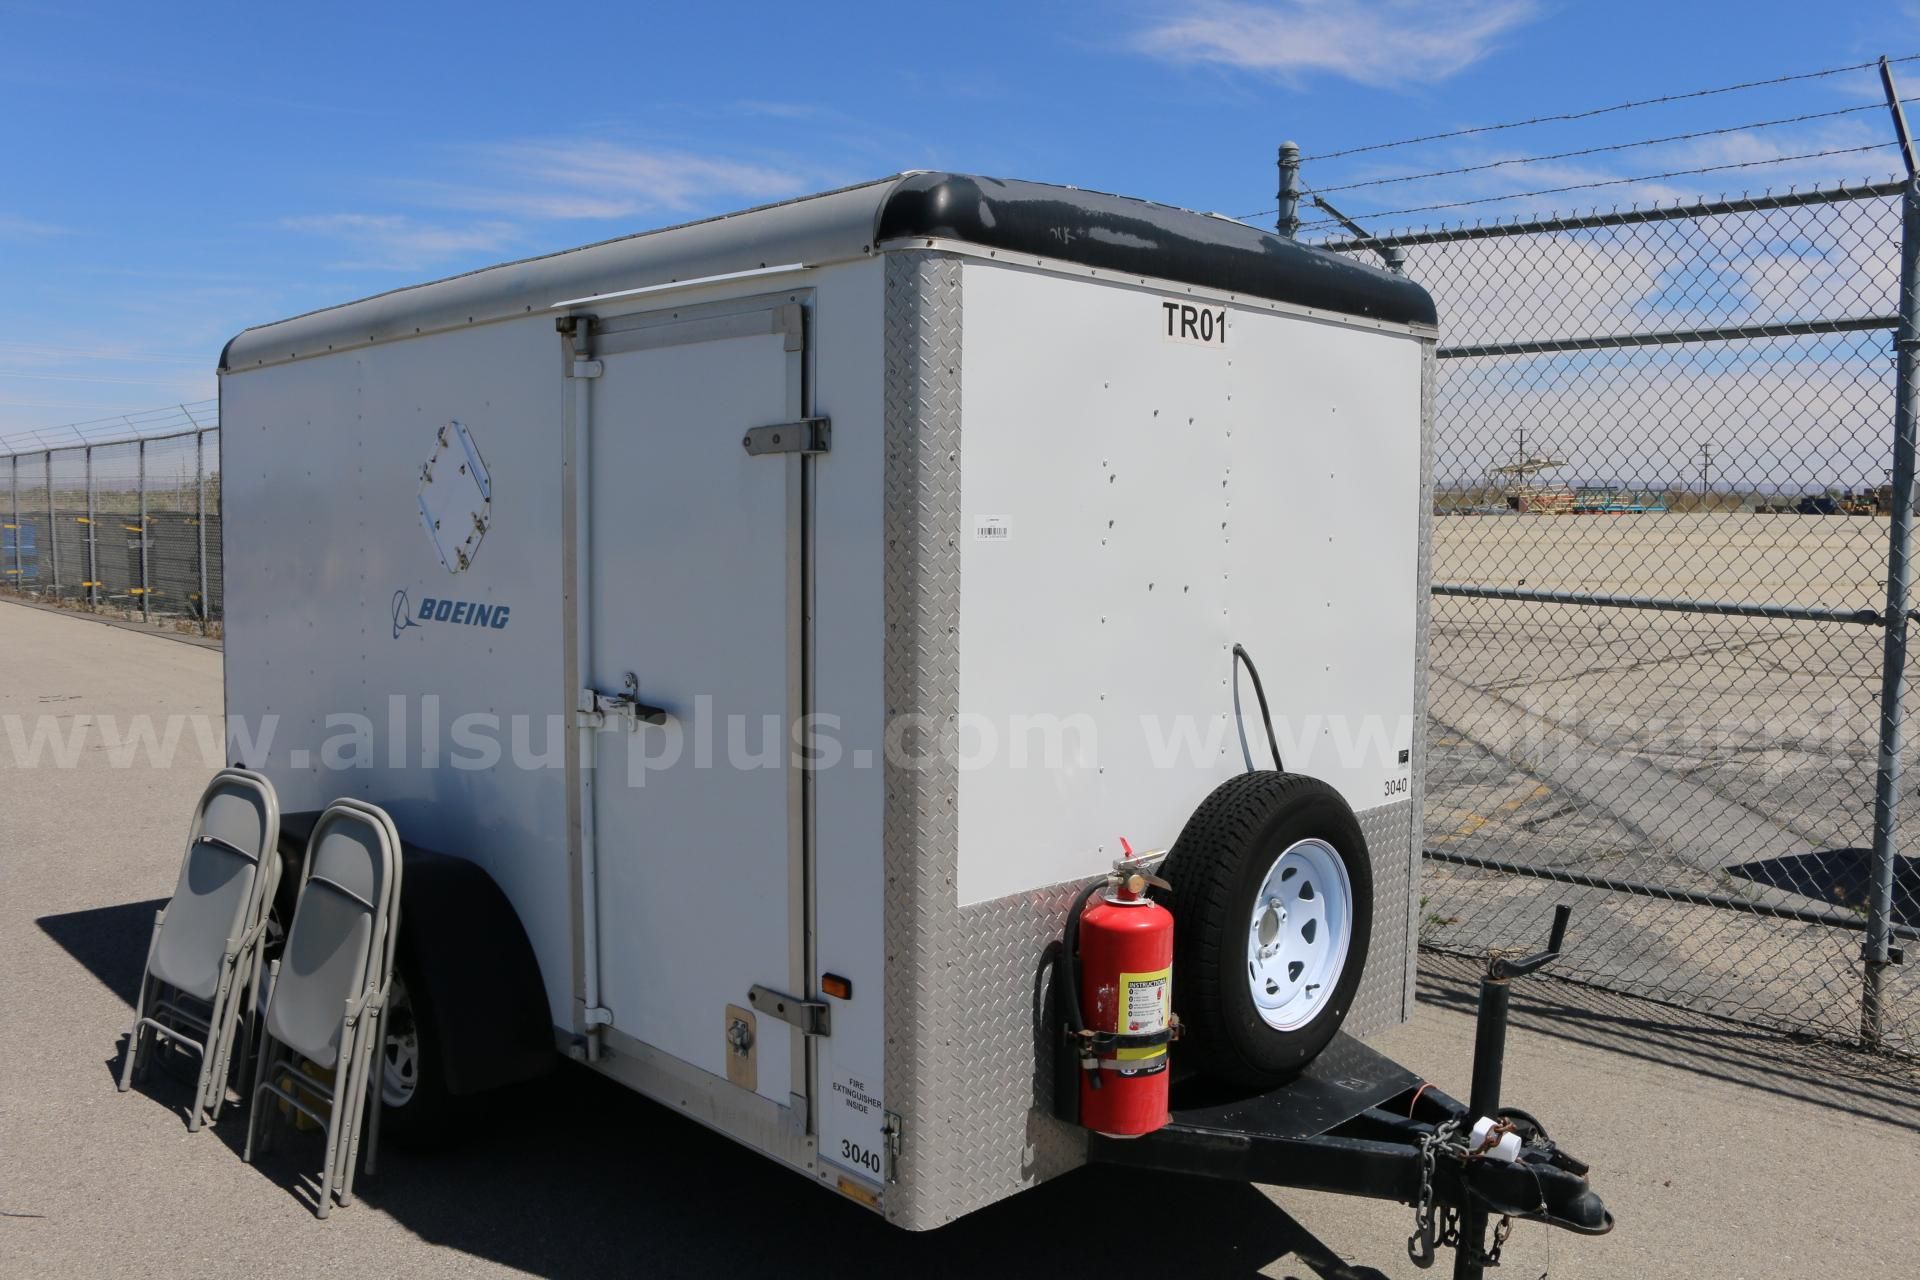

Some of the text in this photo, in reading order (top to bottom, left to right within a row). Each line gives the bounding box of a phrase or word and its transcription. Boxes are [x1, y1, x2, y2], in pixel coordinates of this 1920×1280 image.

[1163, 302, 1225, 343] TR01
[418, 598, 510, 629] BOEING
[1384, 777, 1407, 796] 3040
[832, 1082, 882, 1109] EXTINGUISHER
[849, 1078, 865, 1091] FIRE
[846, 1099, 869, 1114] INSIDE
[841, 1139, 880, 1173] 3040
